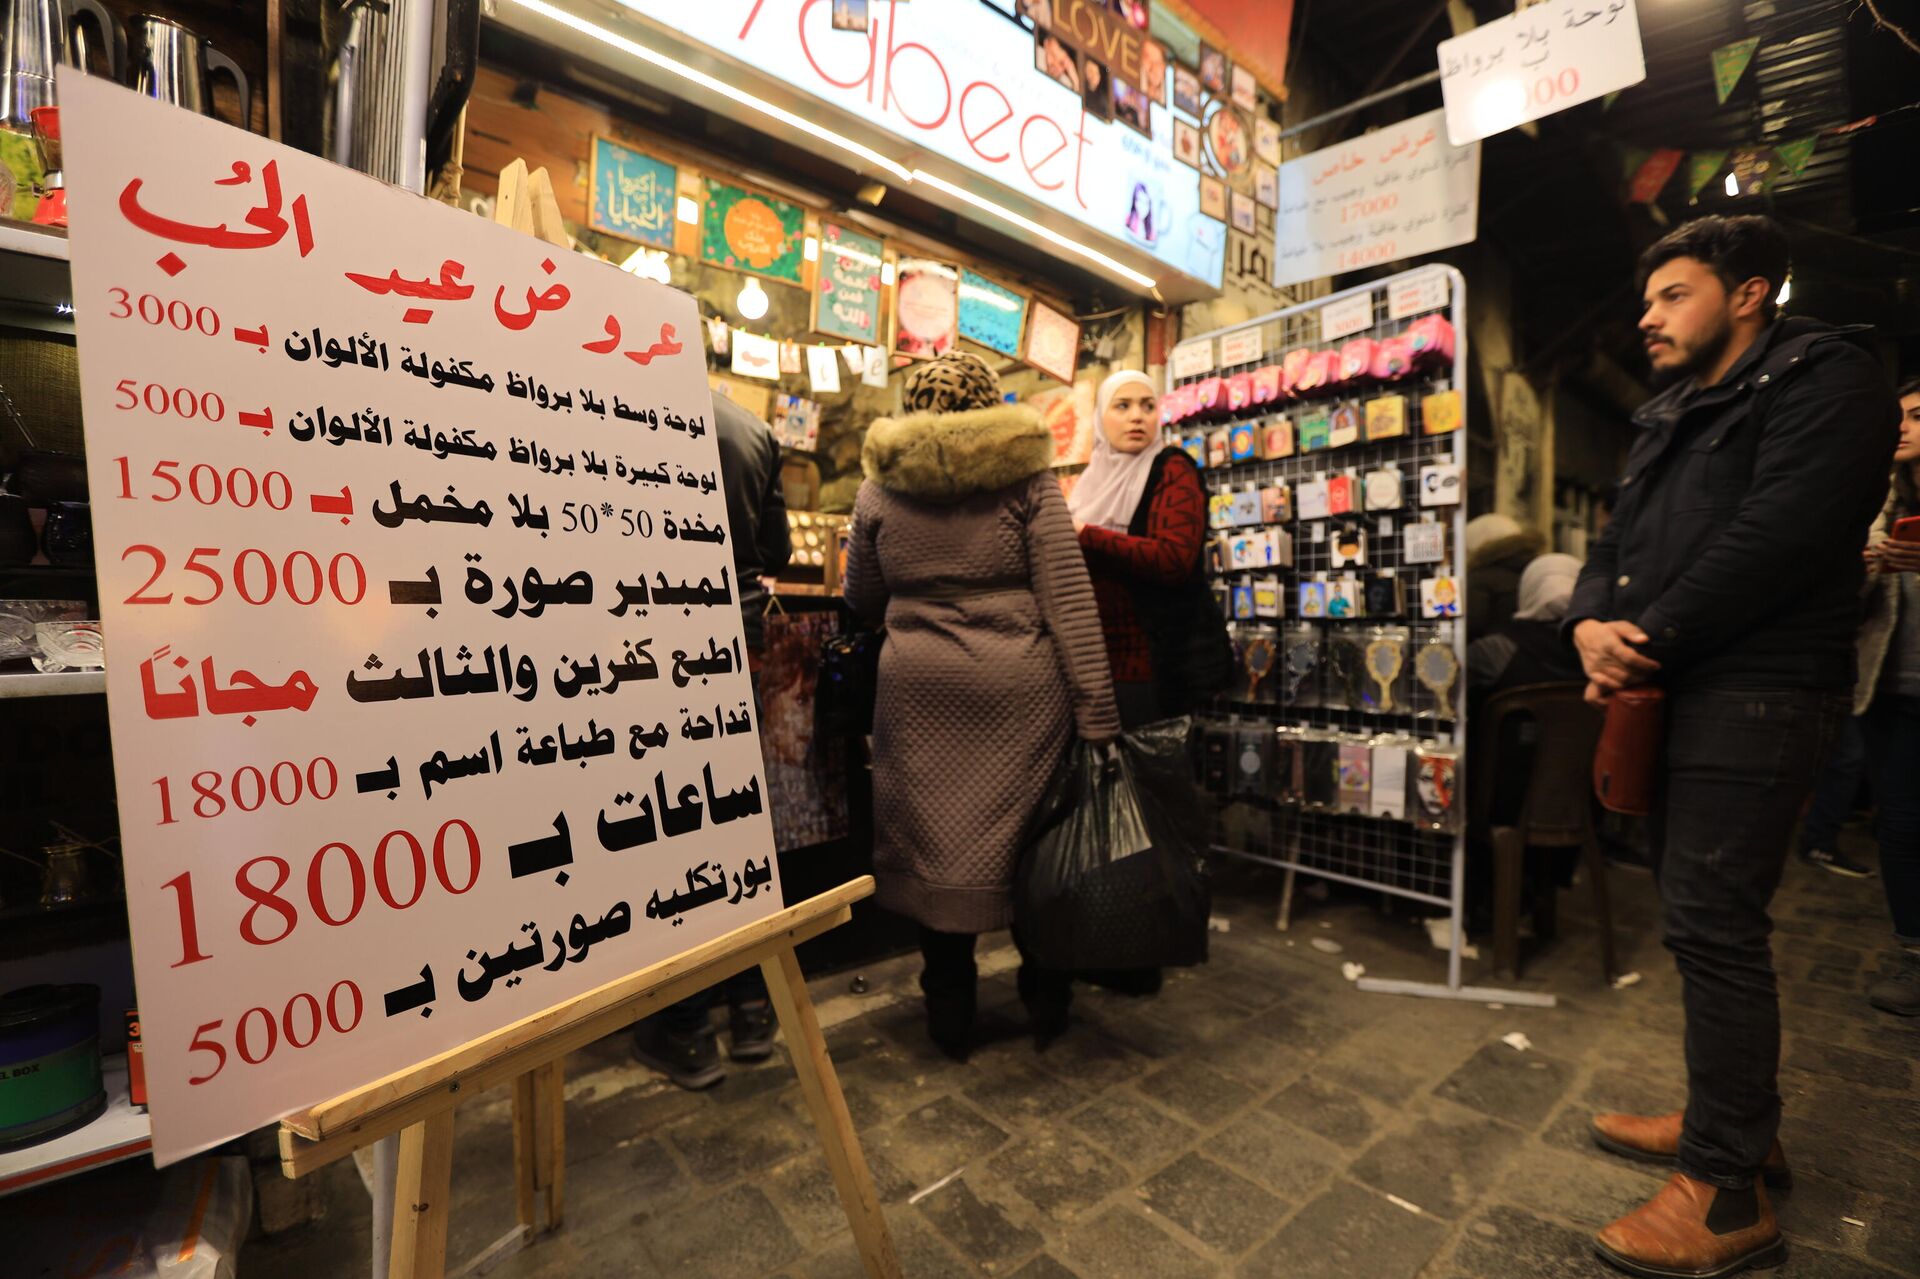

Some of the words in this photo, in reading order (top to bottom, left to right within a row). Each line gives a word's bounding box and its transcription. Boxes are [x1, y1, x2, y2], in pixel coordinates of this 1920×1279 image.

[1051, 0, 1140, 81] LOVE
[1339, 191, 1400, 225] 17000
[108, 286, 222, 337] 3000
[343, 258, 476, 325] عيد
[493, 257, 684, 367] عروض
[283, 325, 391, 373] الألوان
[400, 351, 495, 393] مكفولة
[115, 378, 225, 423] 5000
[506, 370, 574, 414] برواظ
[579, 387, 607, 417] بلا
[612, 394, 659, 432] وسط
[288, 406, 393, 447] الألوان
[404, 423, 498, 461] مكفولة
[663, 409, 707, 440] لوحة
[508, 436, 576, 477] برواظ
[581, 449, 609, 479] بلا
[613, 459, 672, 488] كبيرة
[676, 464, 718, 496] لوحة
[112, 455, 293, 511] 15000
[372, 479, 494, 529] مخمل
[507, 493, 550, 530] بلا
[661, 509, 725, 546] مخدة
[121, 543, 368, 607] 25000
[463, 552, 594, 619] صورة
[607, 565, 732, 618] لمبدير
[346, 643, 538, 703] والثالث
[553, 638, 659, 699] كفرين
[671, 636, 741, 688] اطبع
[515, 718, 615, 769] طباعة
[629, 722, 670, 760] مع
[679, 700, 753, 742] قداحة
[419, 729, 503, 801] اسم
[150, 755, 339, 827] 18000
[596, 761, 765, 852] ساعات
[159, 818, 481, 970] 18000
[644, 854, 773, 927] بورتكليه
[457, 901, 632, 1003] صورتين
[188, 979, 364, 1086] 5000
[11, 1062, 42, 1079] BOX
